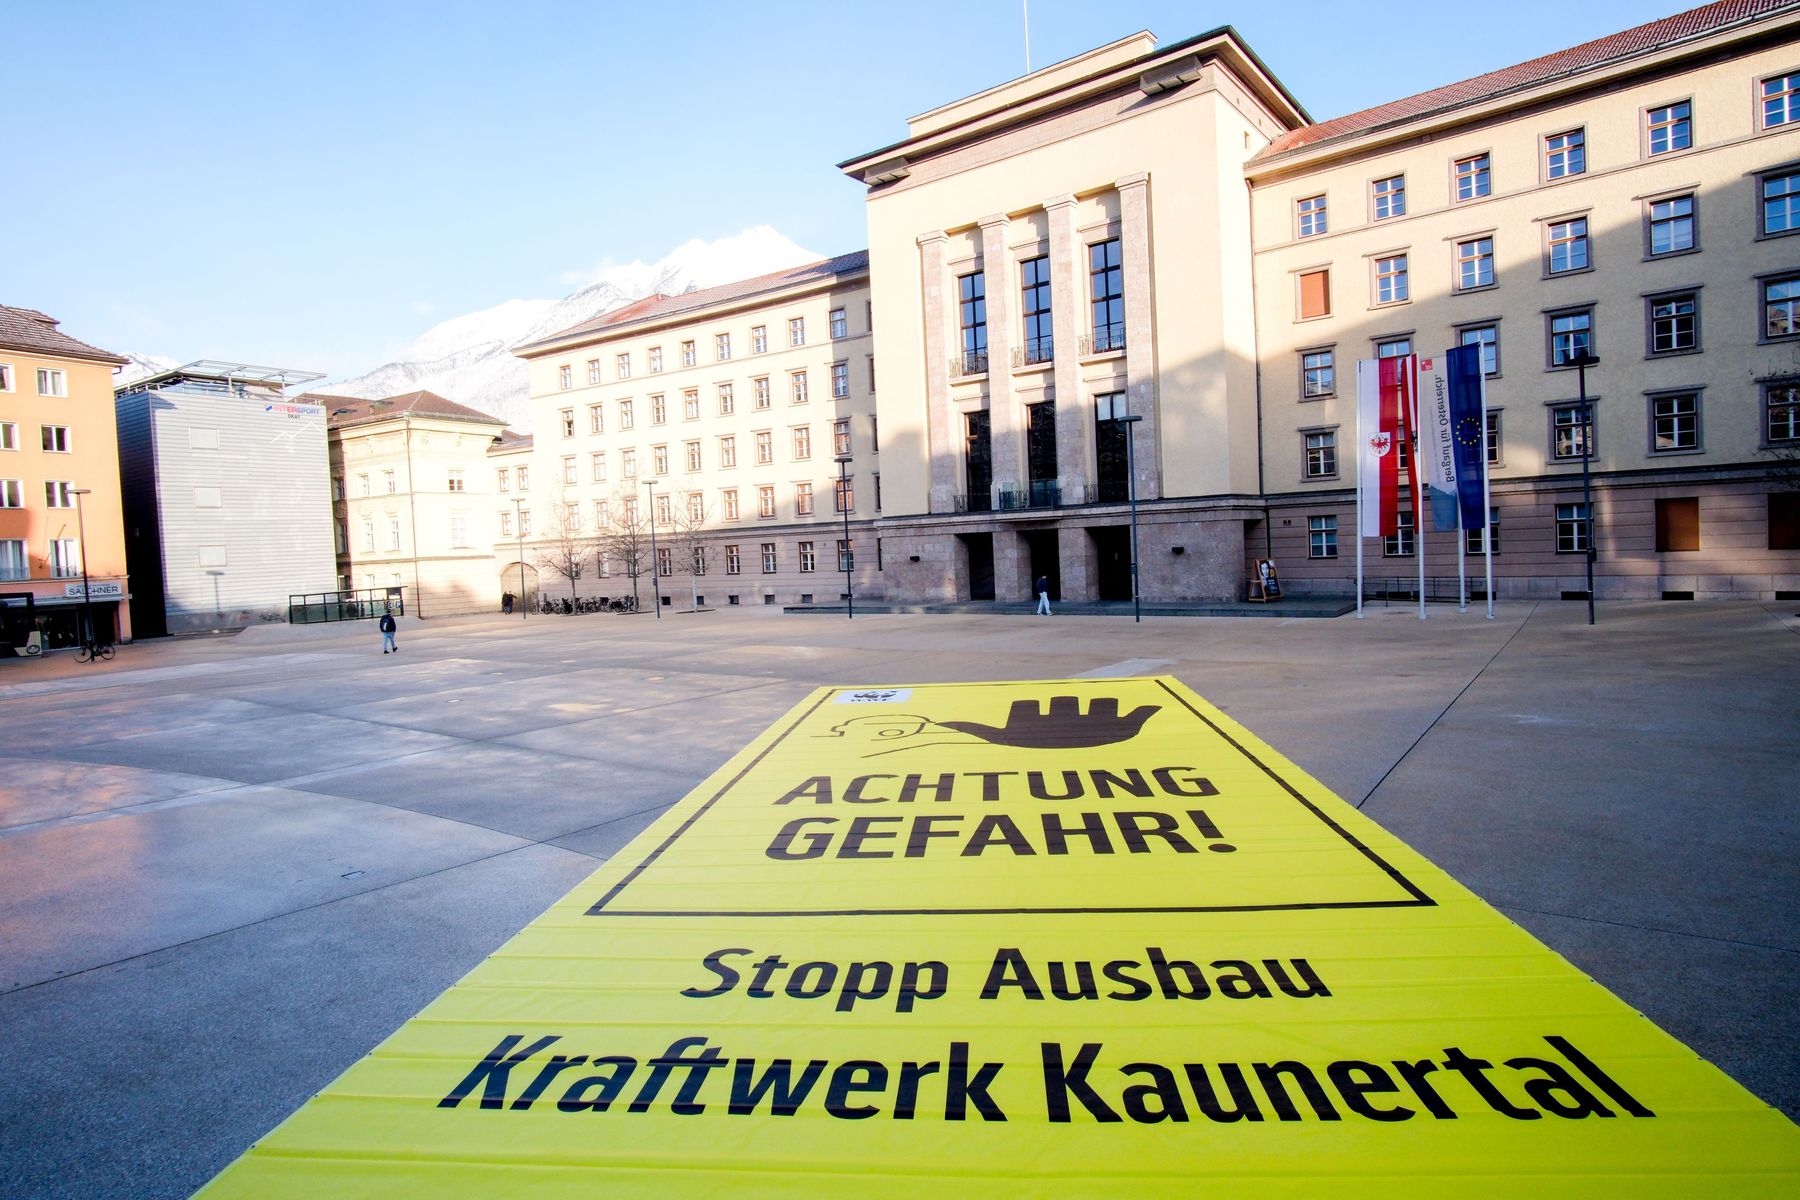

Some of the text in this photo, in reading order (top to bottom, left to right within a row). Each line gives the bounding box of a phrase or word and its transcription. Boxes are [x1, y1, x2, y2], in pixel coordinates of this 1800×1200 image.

[771, 766, 1221, 805] ACHTUNG
[765, 809, 1237, 861] GEFAHR!
[680, 947, 1333, 1013] Stopp Ausbau
[436, 1034, 1657, 1123] Kraftwerk Kaunertal
